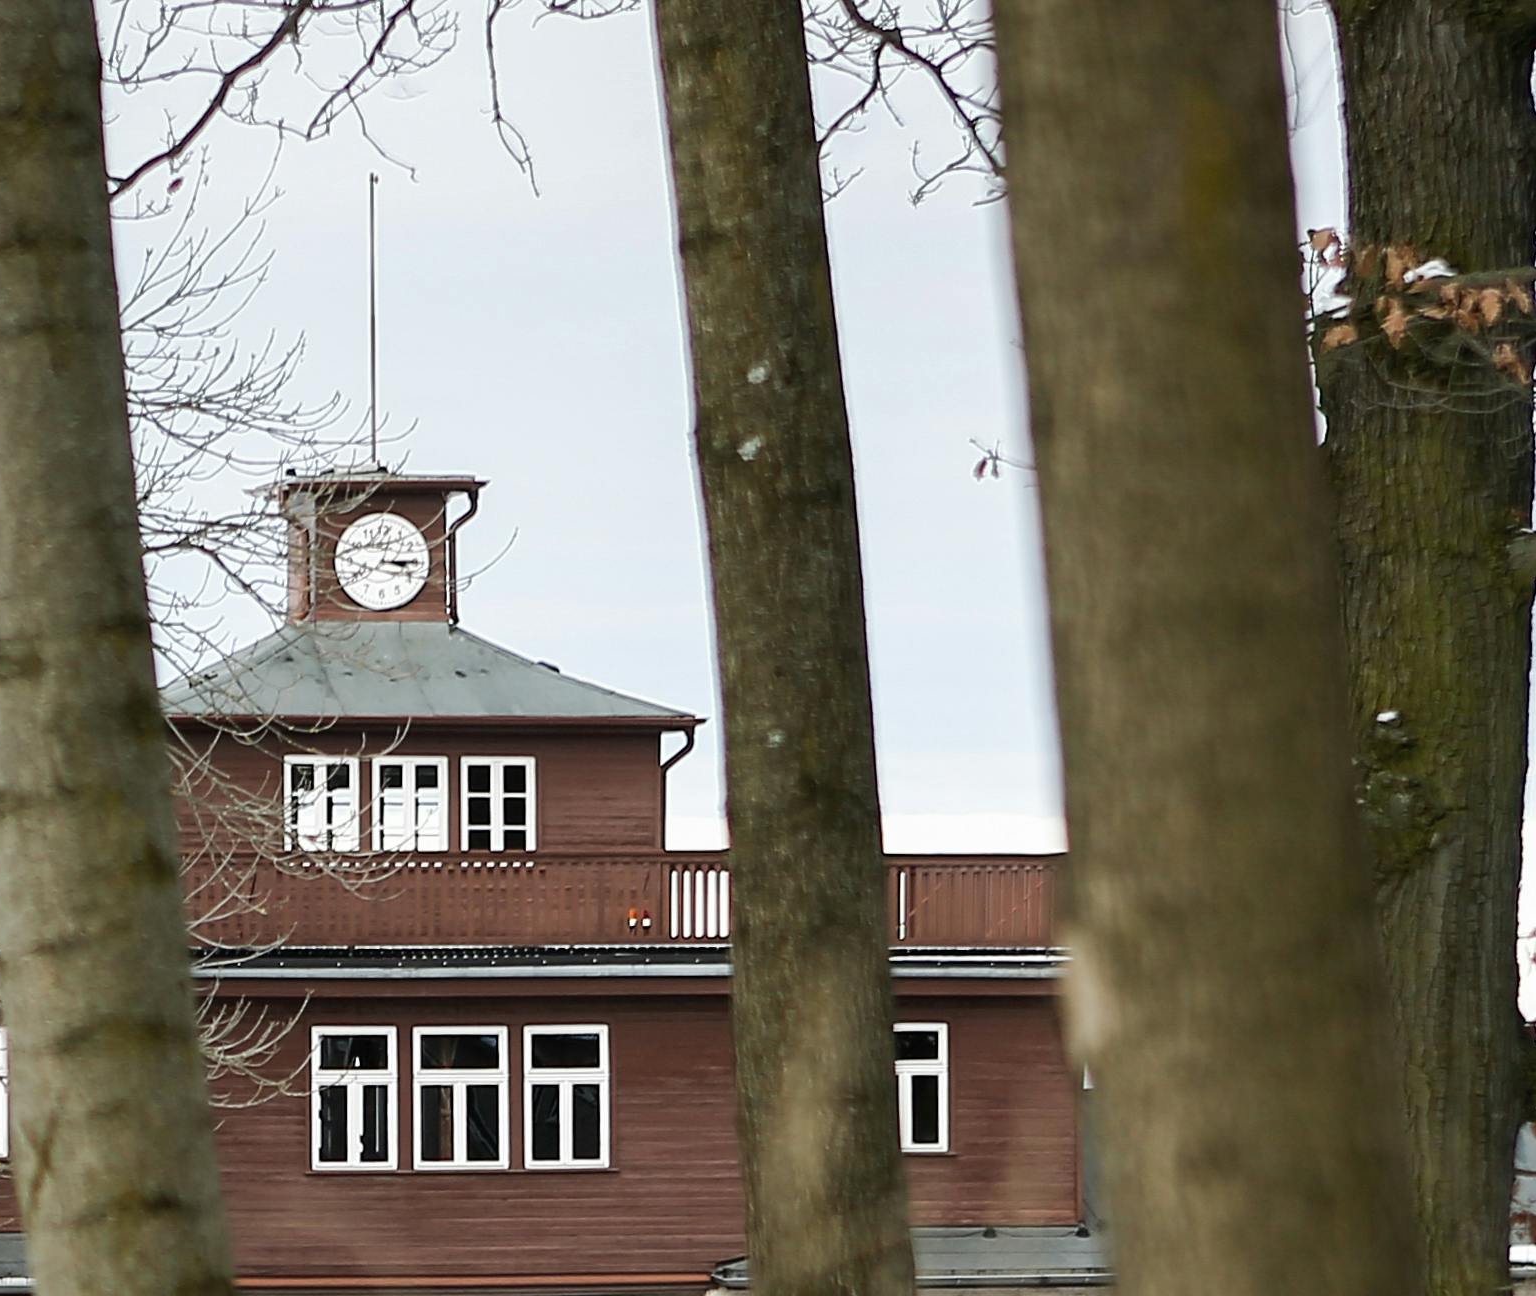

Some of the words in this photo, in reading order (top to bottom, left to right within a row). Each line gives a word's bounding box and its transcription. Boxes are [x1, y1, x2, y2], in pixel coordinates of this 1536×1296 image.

[363, 529, 373, 539] 11
[407, 541, 413, 552] 2
[364, 584, 369, 594] 7
[379, 589, 385, 599] 6
[394, 585, 401, 595] 5
